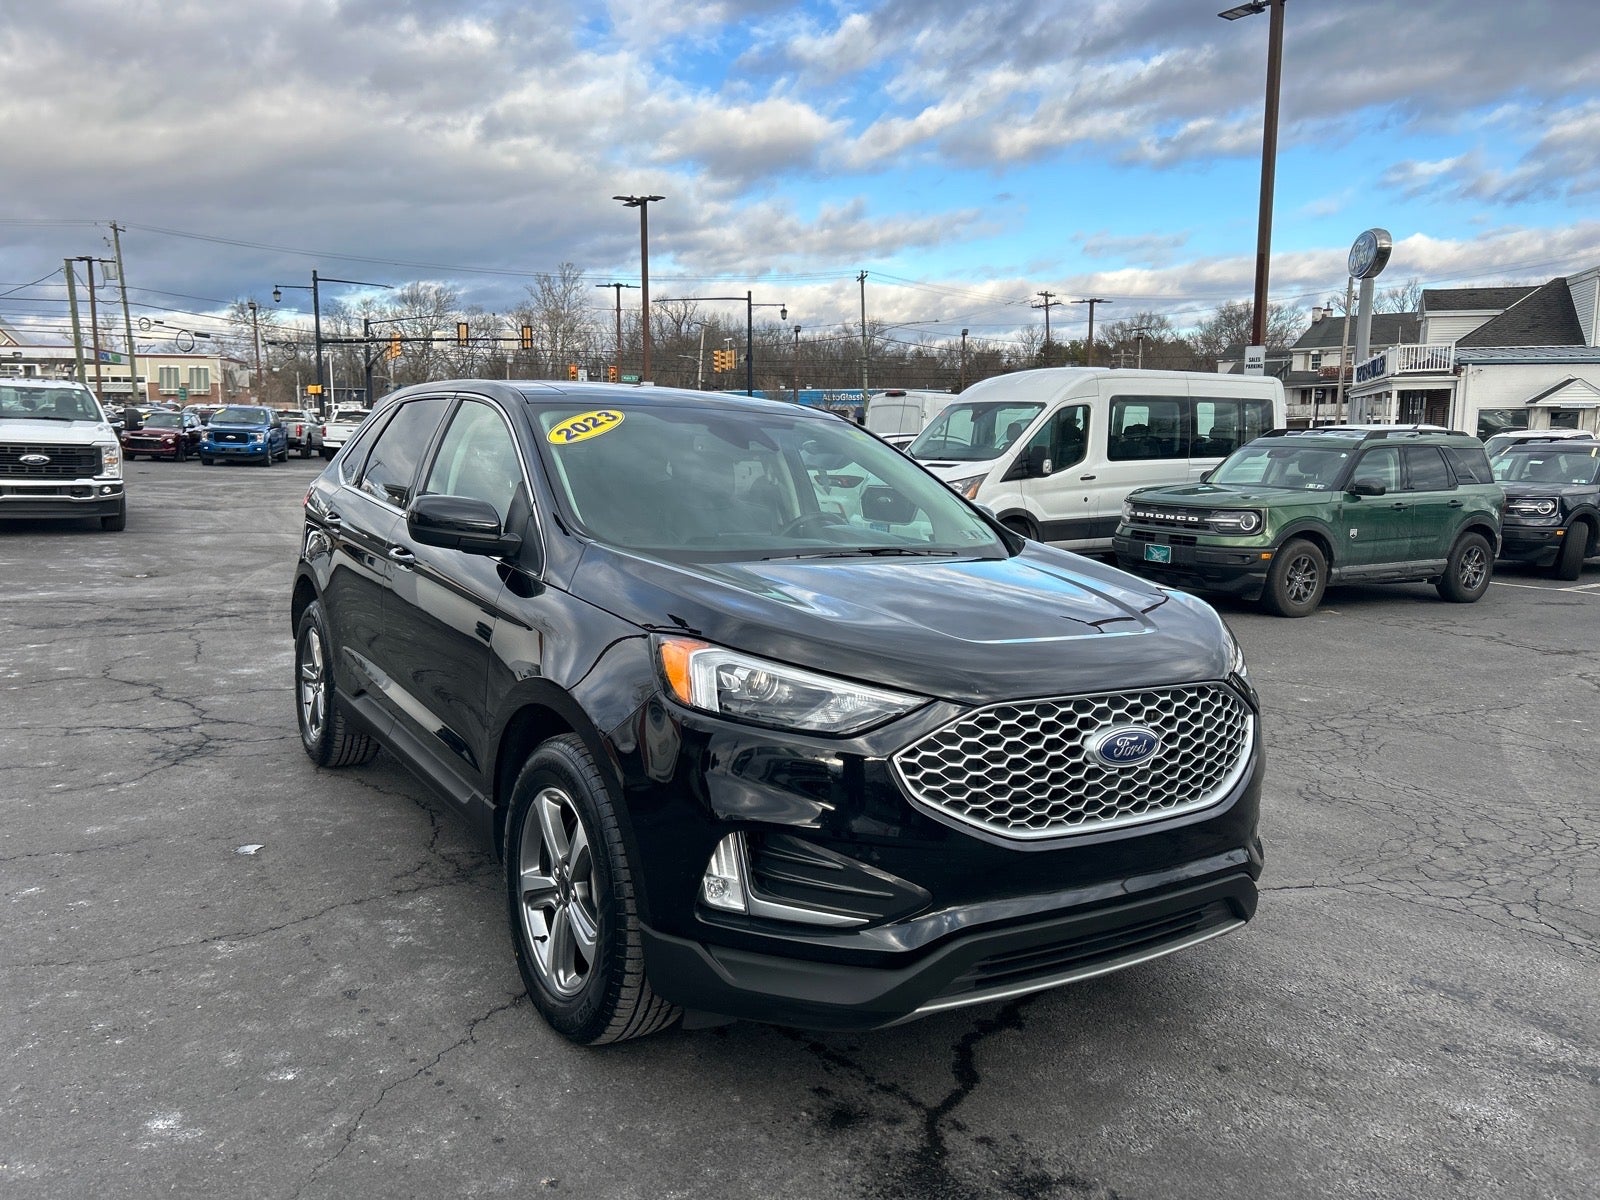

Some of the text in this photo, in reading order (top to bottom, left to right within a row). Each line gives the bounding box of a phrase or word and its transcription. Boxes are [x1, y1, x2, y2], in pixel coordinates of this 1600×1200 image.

[556, 411, 618, 441] 2023
[1136, 511, 1199, 522] BRONCO
[1113, 736, 1148, 758] Ford
